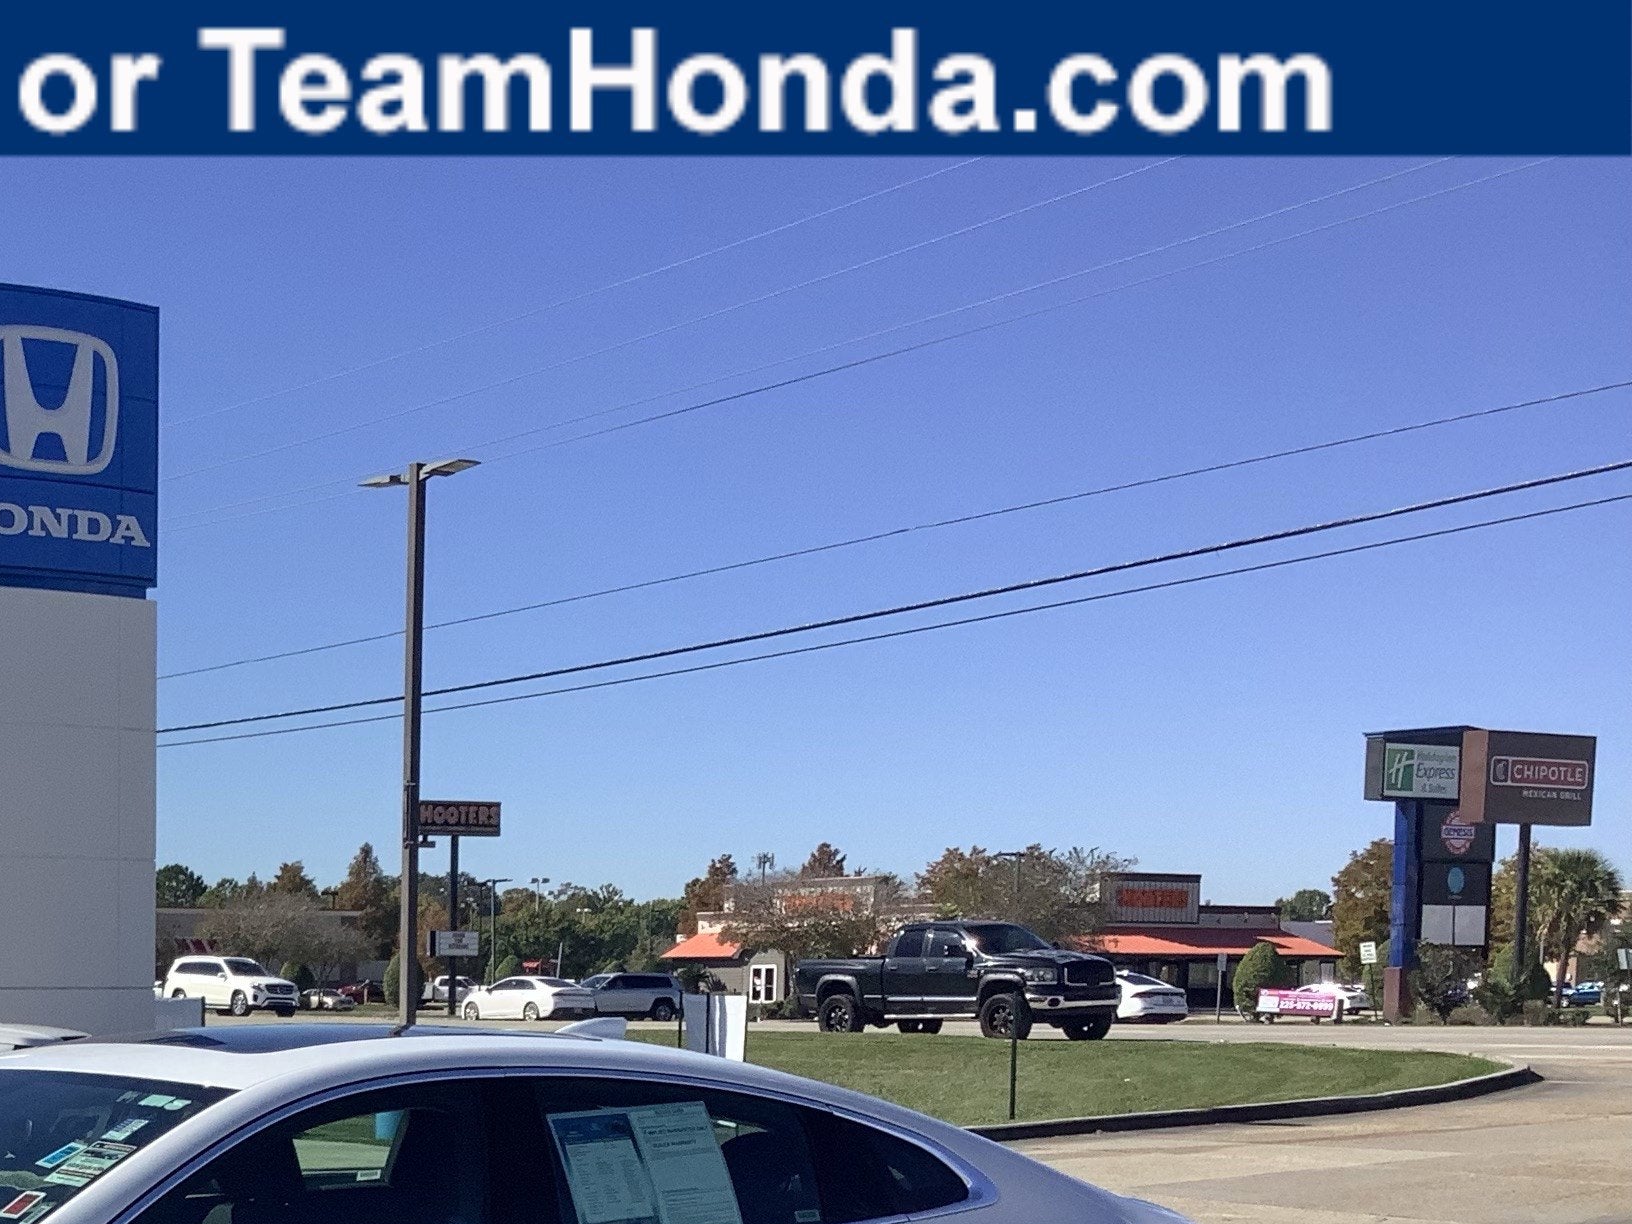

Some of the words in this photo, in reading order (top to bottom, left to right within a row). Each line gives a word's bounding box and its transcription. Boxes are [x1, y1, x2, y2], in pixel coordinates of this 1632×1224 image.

[1416, 762, 1455, 781] Express
[1513, 764, 1583, 783] CHIPOTLE
[1522, 789, 1557, 798] MEXICAN
[1560, 791, 1582, 800] GRILL
[419, 804, 500, 825] HOOTERS
